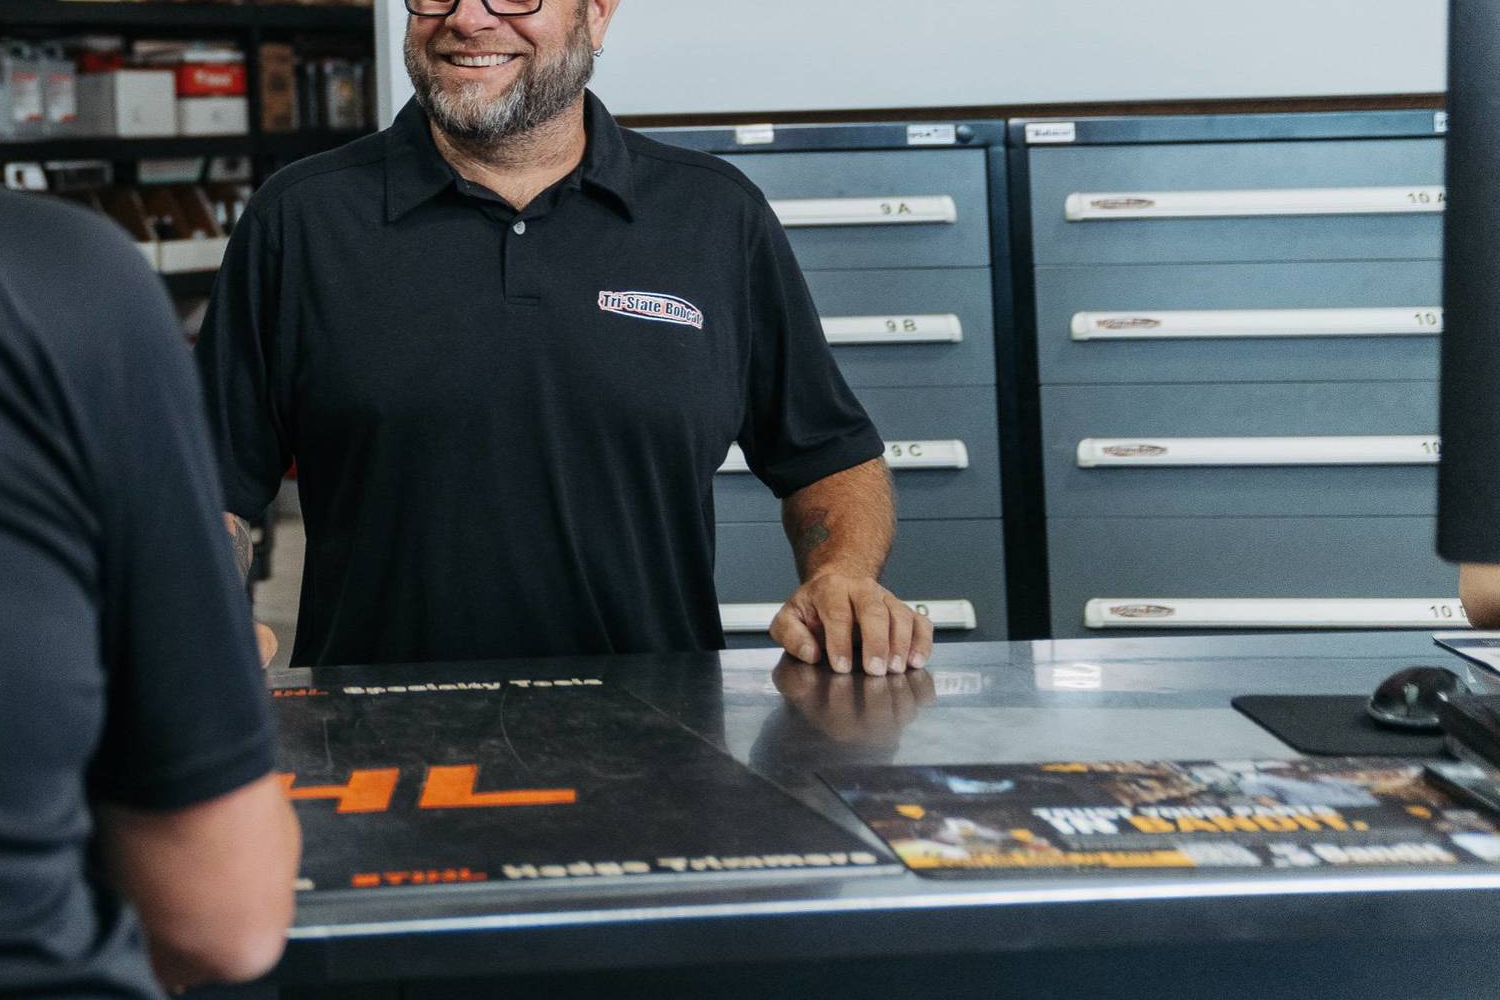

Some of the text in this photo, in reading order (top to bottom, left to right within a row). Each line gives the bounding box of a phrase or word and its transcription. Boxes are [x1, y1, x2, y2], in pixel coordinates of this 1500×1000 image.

[602, 293, 703, 326] Tri-State Bobcat
[343, 681, 500, 695] Specialty
[509, 677, 602, 688] Tools
[351, 866, 488, 888] STIHL
[503, 859, 652, 880] Hedge
[657, 850, 878, 872] Trimmers
